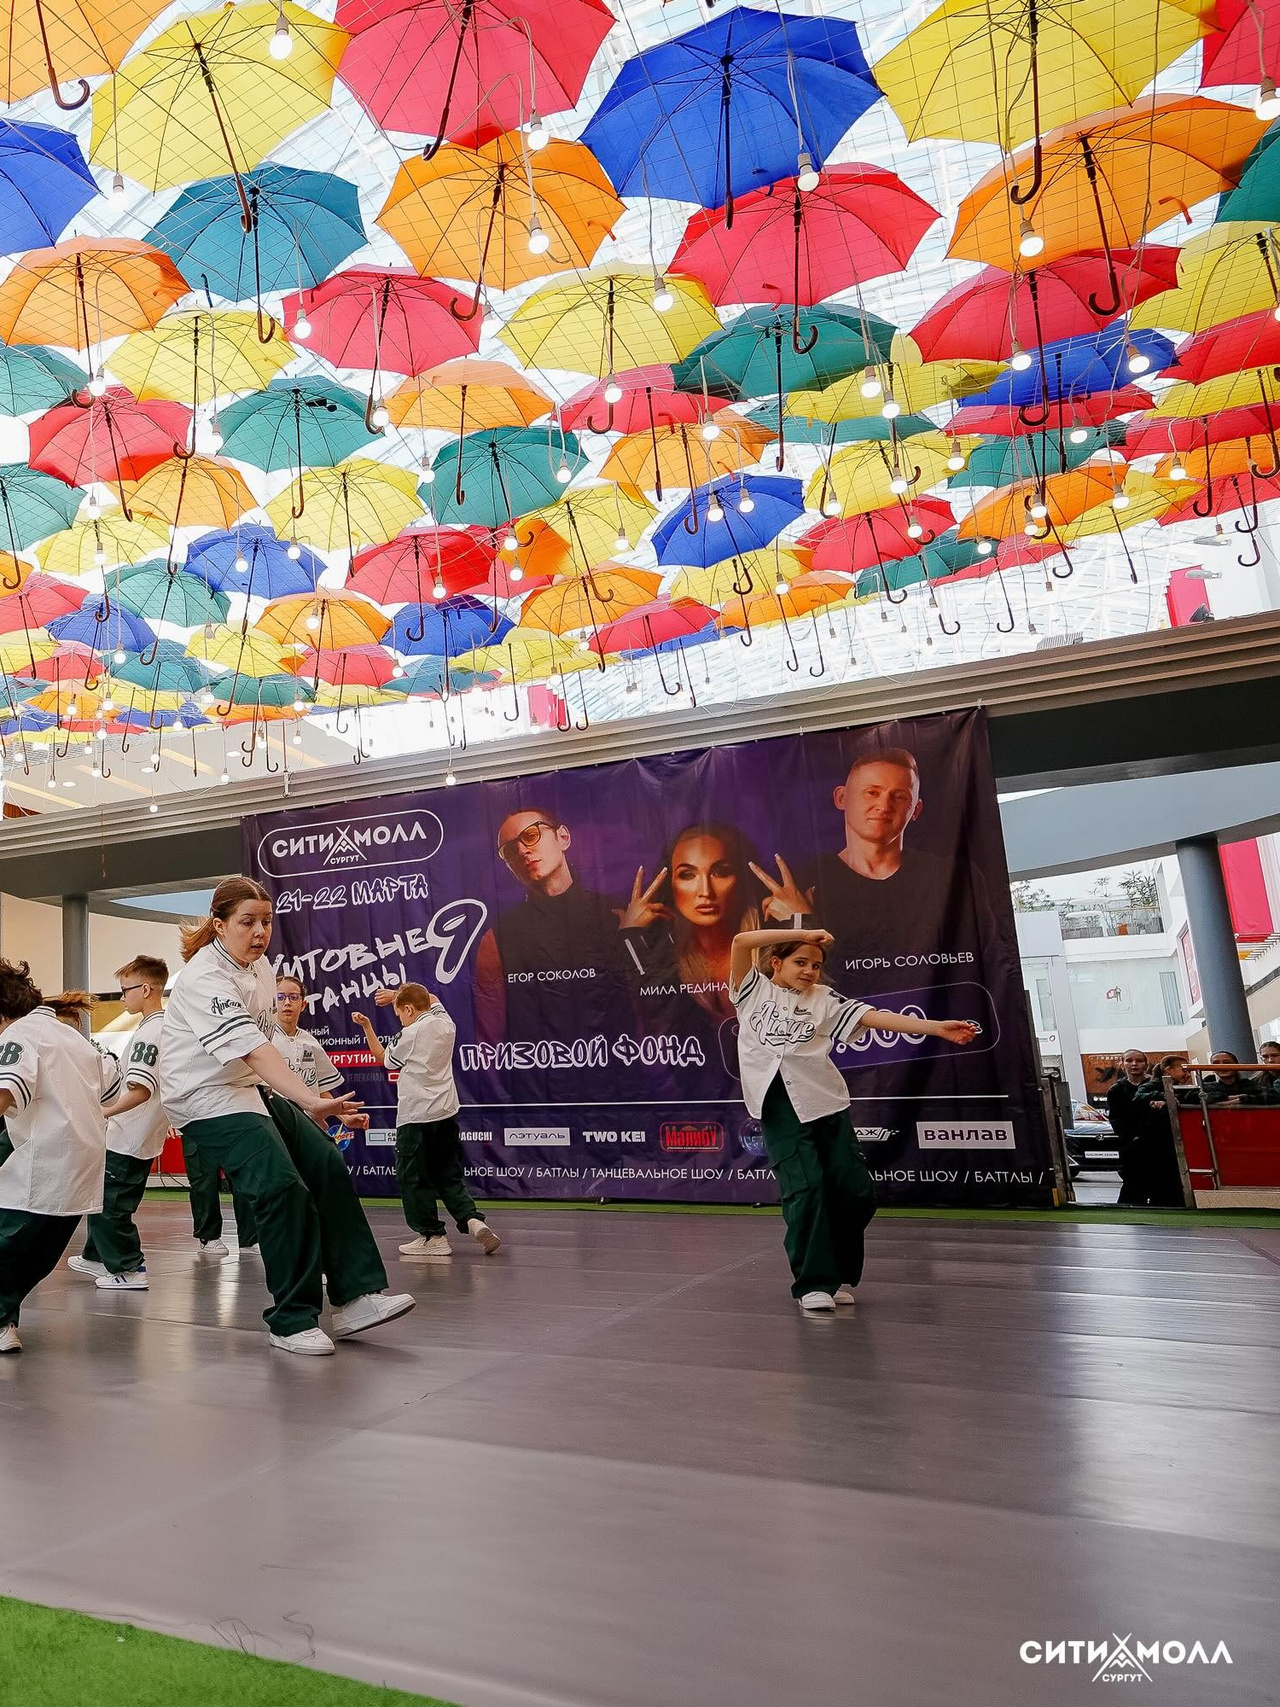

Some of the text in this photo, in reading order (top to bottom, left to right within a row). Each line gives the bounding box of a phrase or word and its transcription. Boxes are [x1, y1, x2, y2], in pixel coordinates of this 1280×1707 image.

[330, 854, 360, 865] СУРГУТ
[351, 873, 429, 906] МАРТА
[845, 951, 974, 970] ИГОРЬ СОЛОВЬЕВ
[507, 968, 596, 983] ЕГОР СОКОЛОВ
[639, 981, 729, 997] МИЛА РЕДИНА
[130, 1041, 159, 1067] 88
[460, 1034, 608, 1071] ПРИЗОВОЙ
[459, 1131, 493, 1142] AGUCHI
[582, 1131, 646, 1143] TWO KEI
[923, 1129, 1008, 1141] ванлав
[496, 1167, 525, 1178] ШОУ
[536, 1167, 580, 1178] БАТТЛЫ
[591, 1167, 688, 1180] ТАНЦЕВАЛЬНОЕ
[691, 1168, 724, 1180] ШОУ
[737, 1169, 776, 1181] БАТТЛ
[920, 1170, 958, 1183] ШОУ
[974, 1171, 1033, 1183] БАТТЛЫ
